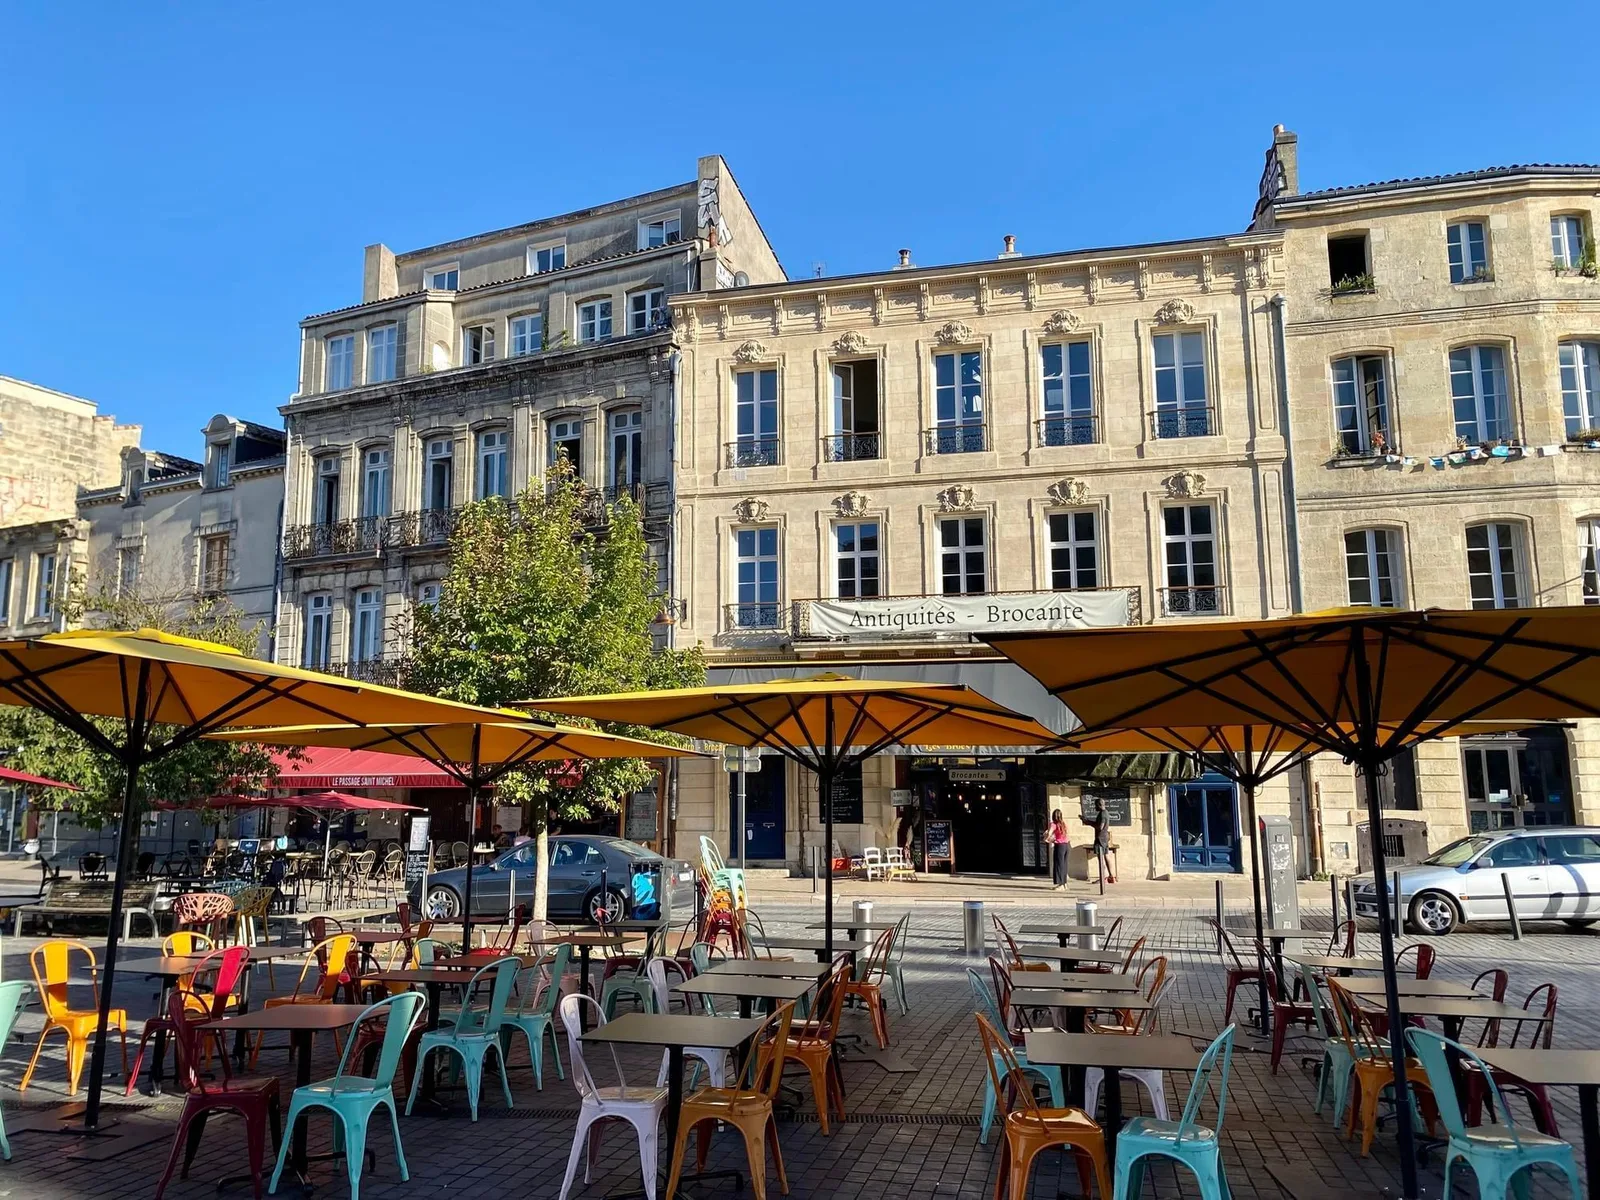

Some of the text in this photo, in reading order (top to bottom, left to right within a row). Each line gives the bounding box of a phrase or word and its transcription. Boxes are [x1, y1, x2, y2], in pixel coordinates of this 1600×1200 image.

[849, 605, 955, 631] Antiquités
[986, 604, 1084, 623] Brocante
[950, 771, 989, 779] Brocantes
[332, 776, 395, 786] LE PASSAGE SAINT MICHEL
